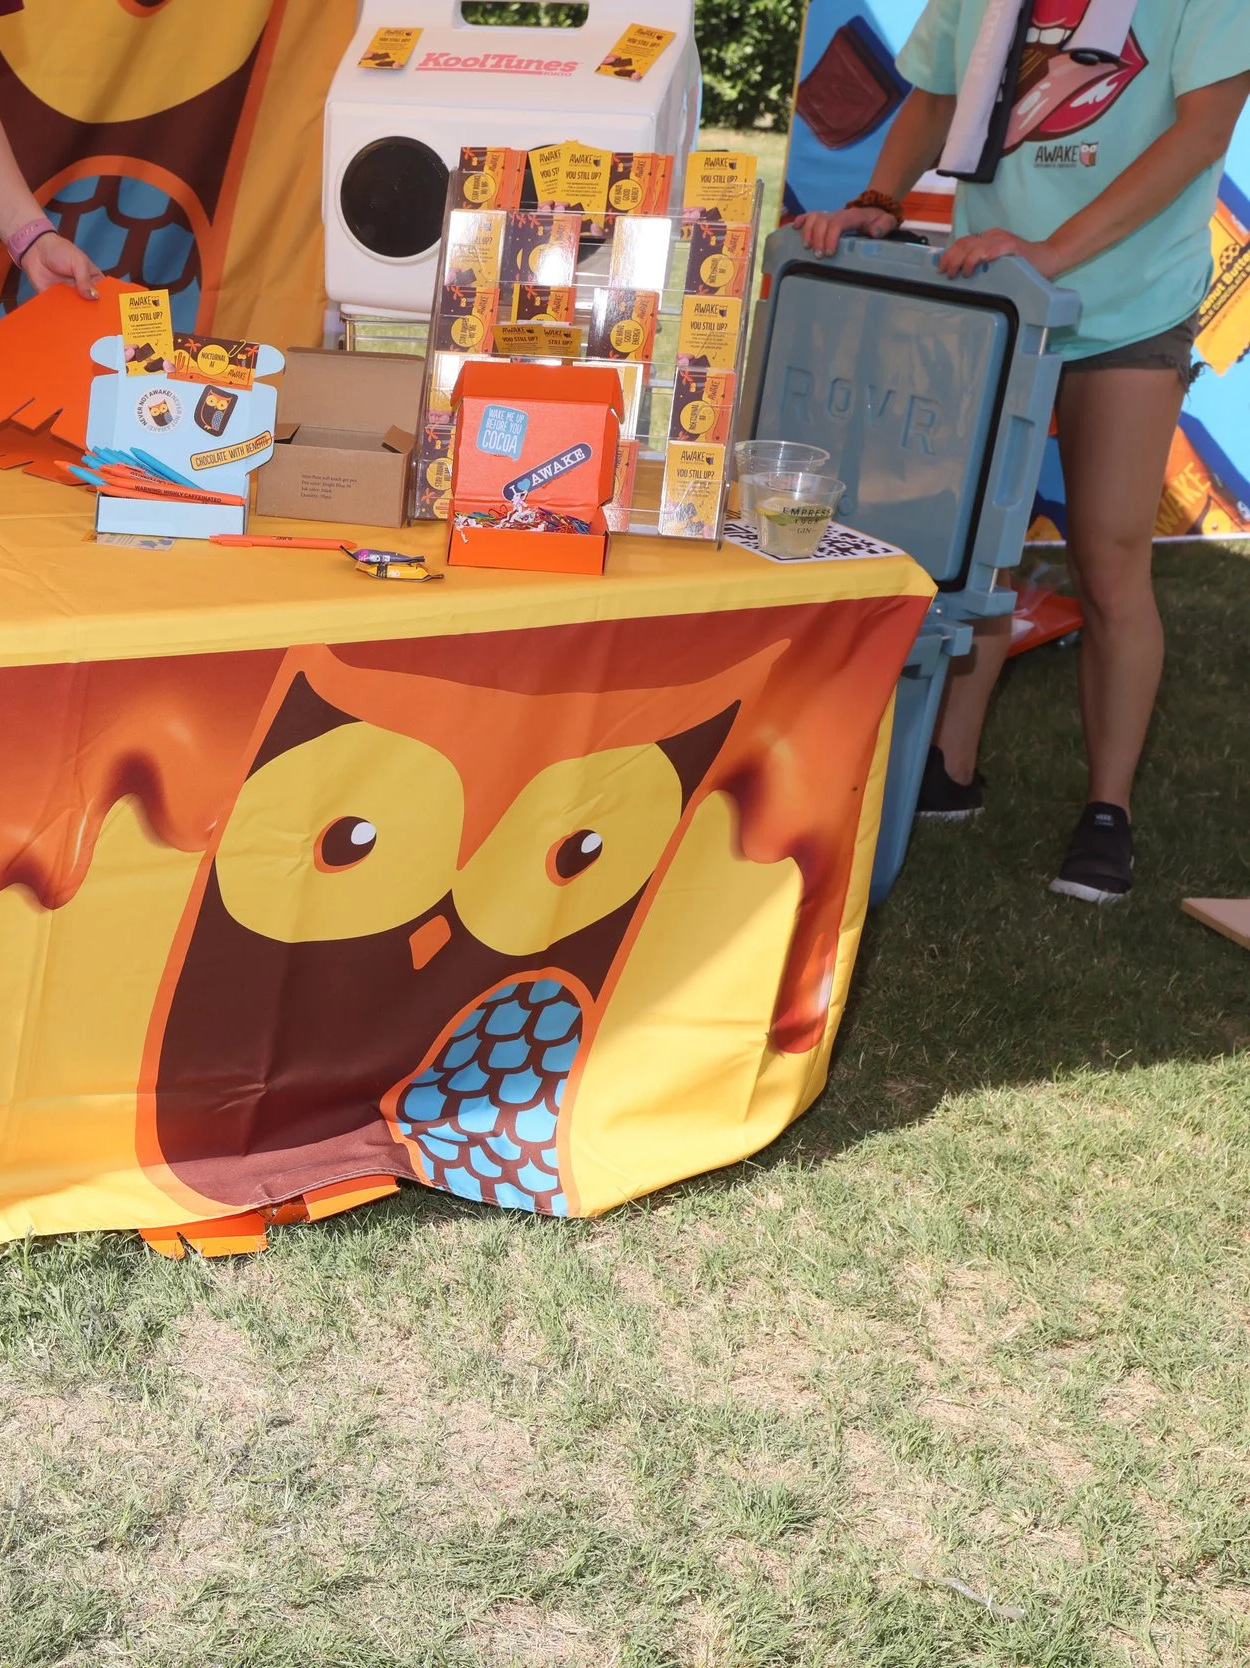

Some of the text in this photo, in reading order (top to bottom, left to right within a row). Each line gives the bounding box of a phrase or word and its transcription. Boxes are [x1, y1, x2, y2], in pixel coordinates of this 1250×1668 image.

[418, 52, 579, 73] KoolTunes
[539, 150, 561, 164] AWAKE
[569, 154, 593, 167] AWAKE
[1034, 145, 1078, 162] AWAKE
[636, 160, 647, 179] AWAKE
[704, 157, 729, 169] AWAKE
[540, 168, 551, 178] YOU
[566, 171, 577, 180] YOU
[577, 171, 589, 180] STILL
[590, 171, 602, 180] UP?
[700, 175, 738, 185] YOU STILL UP?
[631, 186, 640, 203] ENERGY
[728, 233, 740, 254] AWAKE
[1198, 282, 1226, 315] eanut
[1221, 250, 1250, 285] Butte
[129, 296, 151, 307] AWAKE
[694, 303, 719, 315] AWAKE
[128, 311, 163, 322] YOU STILL UP?
[690, 321, 728, 331] YOU STILL UP?
[624, 329, 632, 342] GOOD
[632, 328, 641, 345] ENERGY
[201, 352, 226, 362] NOCTURNAL
[227, 369, 248, 380] AWAKE
[708, 380, 720, 400] AWAKE
[137, 389, 173, 426] NEVER NOT AWAKE!
[780, 365, 942, 456] ROVR
[488, 408, 525, 423] WAKE ME UP
[486, 418, 522, 434] BEFORE YOU
[482, 430, 519, 454] COCOA
[195, 452, 227, 467] CHOCOLATE
[229, 447, 245, 459] WITH
[681, 450, 706, 461] AWAKE
[531, 448, 586, 486] AWAKE
[677, 469, 714, 479] YOU STILL UP?
[134, 485, 222, 503] WARNING: HIGHLY CAFFEINATED
[782, 507, 833, 517] EMPRESS
